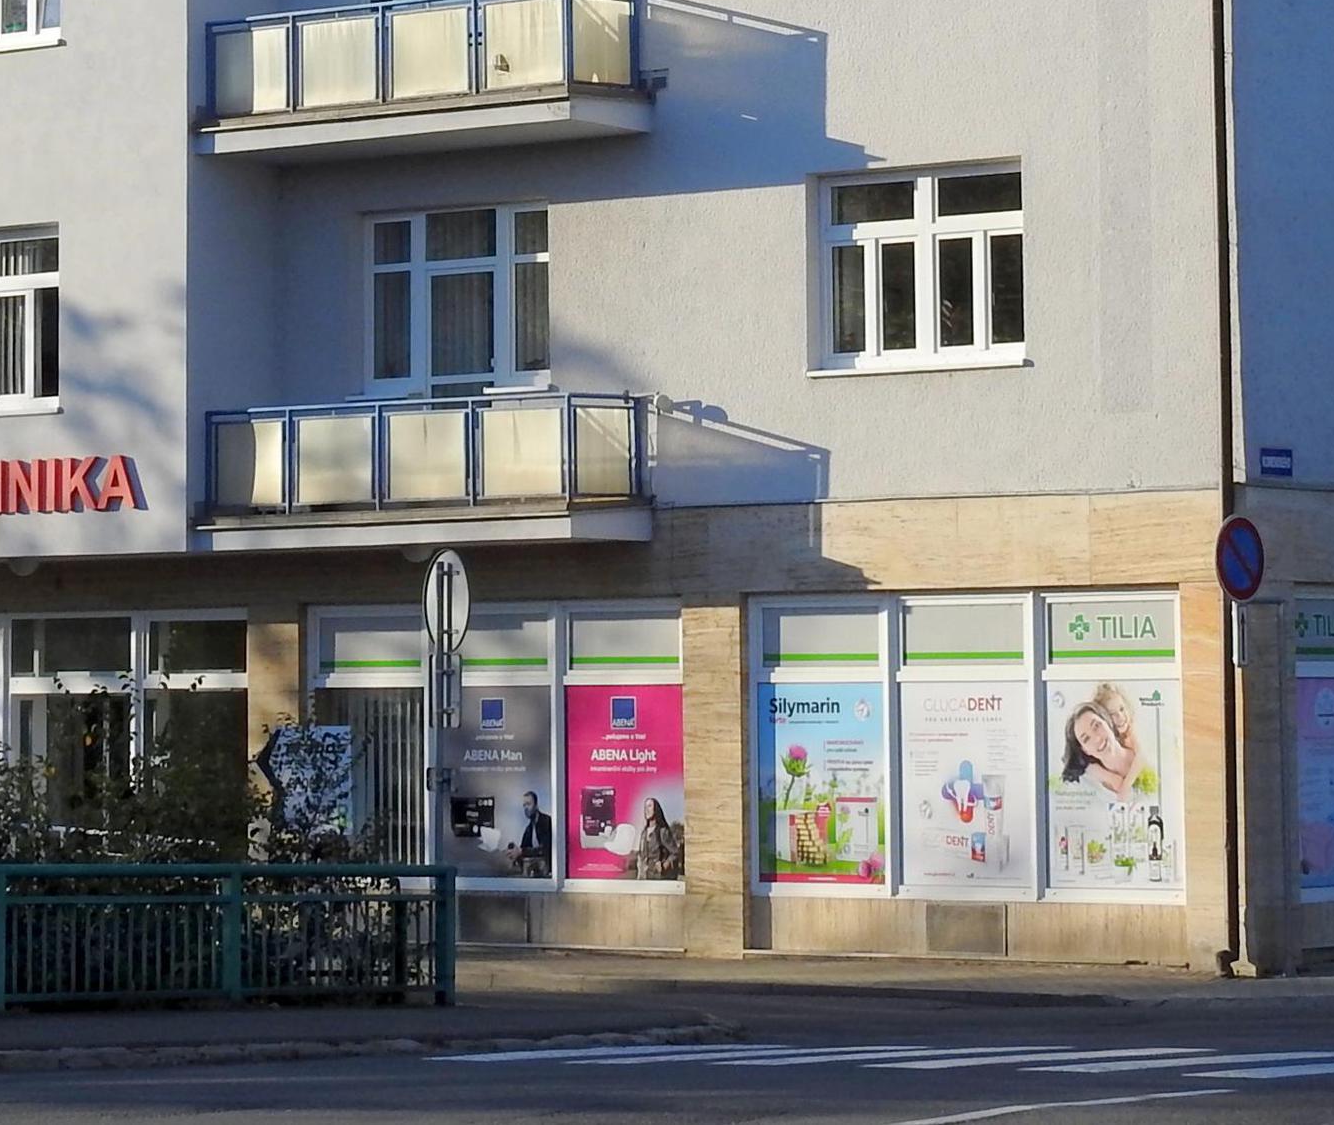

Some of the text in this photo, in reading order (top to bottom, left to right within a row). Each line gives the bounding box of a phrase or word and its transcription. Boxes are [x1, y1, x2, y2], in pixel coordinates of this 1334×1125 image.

[1097, 616, 1156, 639] TILIA
[769, 697, 841, 718] Silymarin
[464, 749, 523, 762] ABENA Man
[591, 749, 657, 764] ABENA Light
